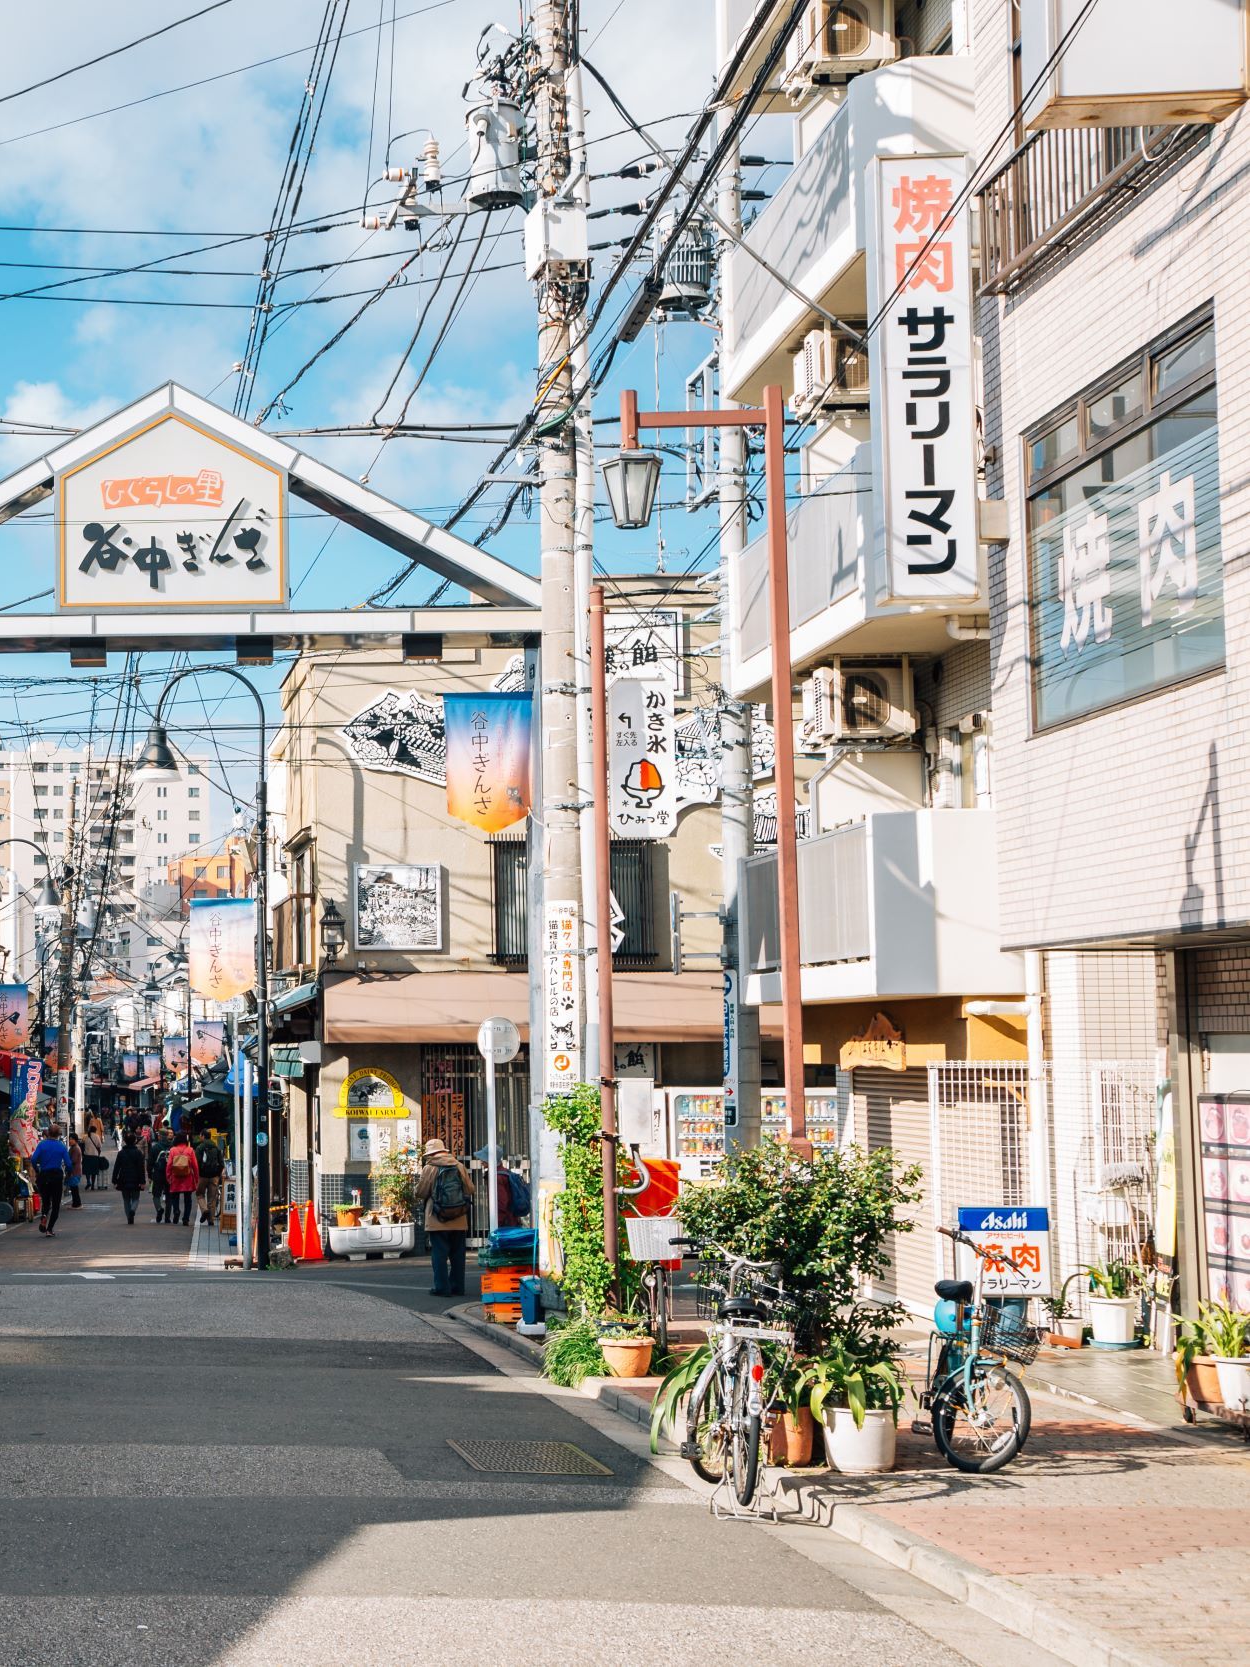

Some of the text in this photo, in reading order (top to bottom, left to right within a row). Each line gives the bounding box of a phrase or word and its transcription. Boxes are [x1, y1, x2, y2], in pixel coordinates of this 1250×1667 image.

[892, 175, 953, 294] 焼肉
[898, 306, 957, 575] サラリーマン
[104, 469, 223, 508] ひぐらしの里
[79, 497, 270, 589] 谷中ぎんざ
[1058, 470, 1198, 661] 焼肉
[616, 739, 638, 747] 左入る
[646, 690, 667, 754] かき氷
[470, 711, 492, 815] 谷中ぎんざ
[617, 811, 670, 825] ひみつ堂
[209, 911, 223, 989] 谷中ぎんざ
[0, 992, 9, 1044] 谷中ぎんざ
[981, 1211, 1028, 1230] Asahi
[974, 1279, 1041, 1289] ラリーマン
[976, 1243, 1041, 1273] 焼肉
